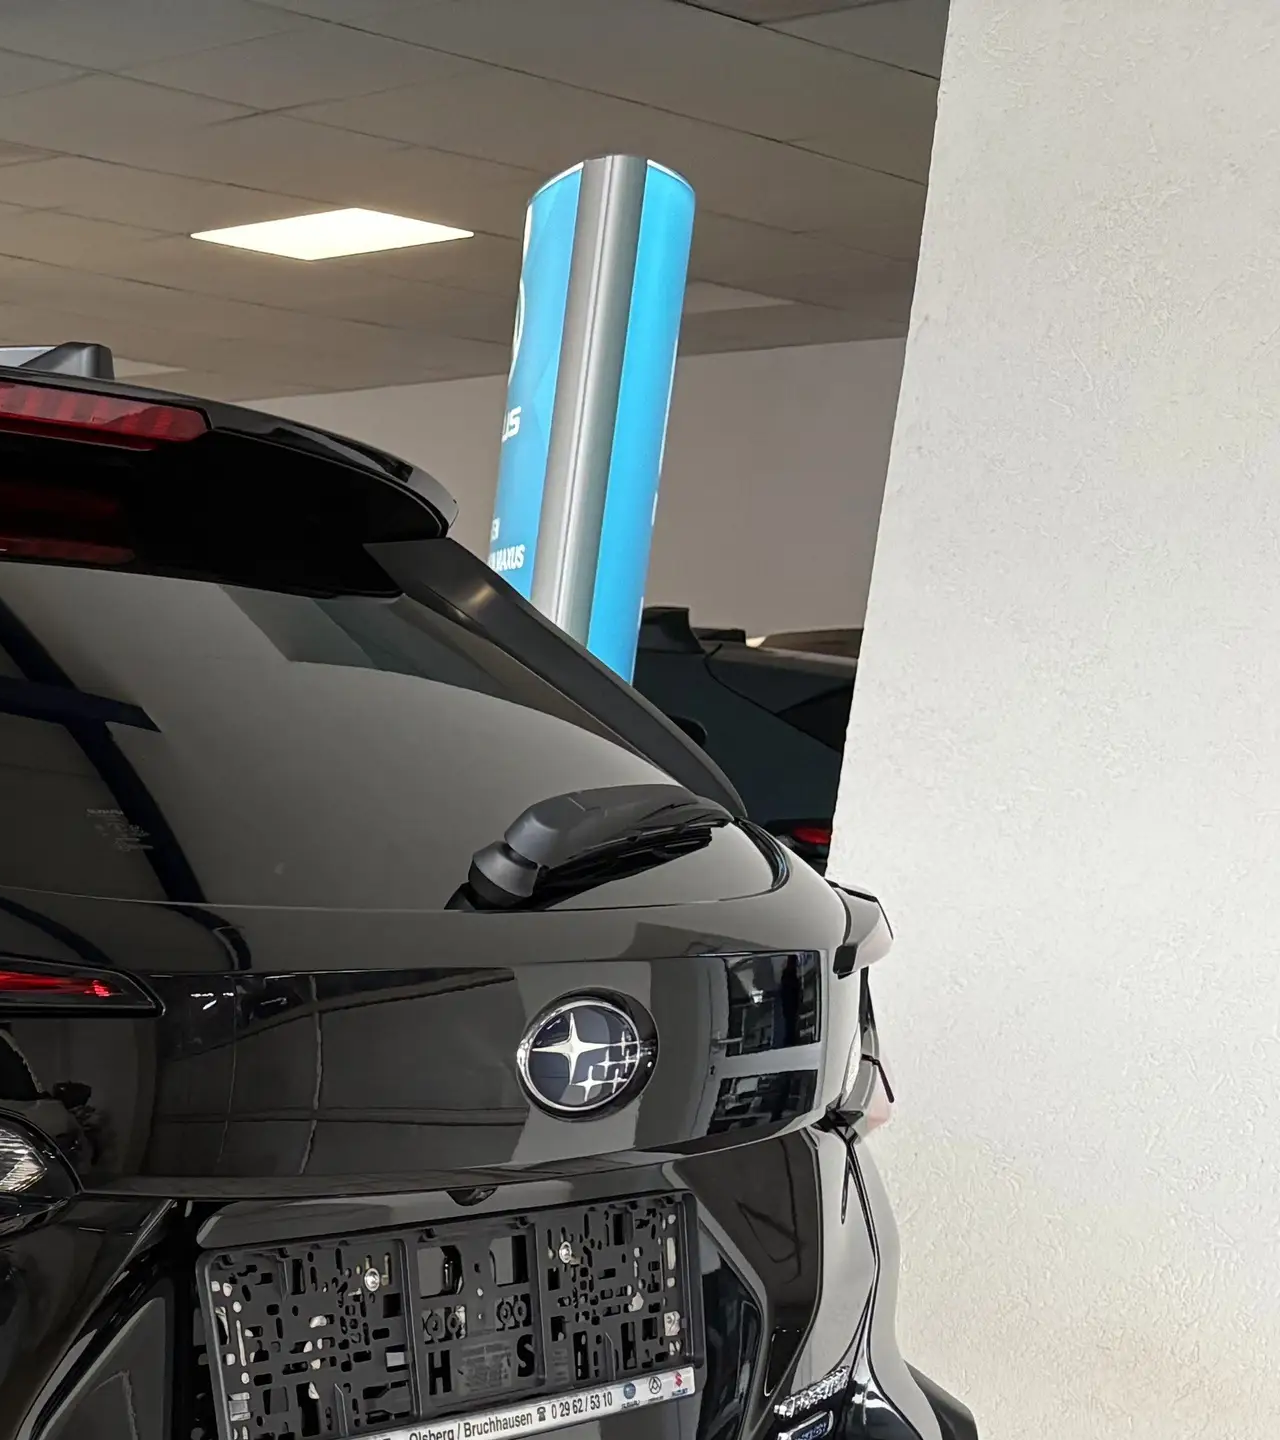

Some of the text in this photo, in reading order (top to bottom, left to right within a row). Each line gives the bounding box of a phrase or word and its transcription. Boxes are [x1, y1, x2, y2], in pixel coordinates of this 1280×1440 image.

[463, 1411, 533, 1438] Bruchhausen
[559, 1404, 570, 1418] 29
[572, 1401, 583, 1415] 62
[590, 1395, 601, 1410] 53
[603, 1391, 613, 1406] 10
